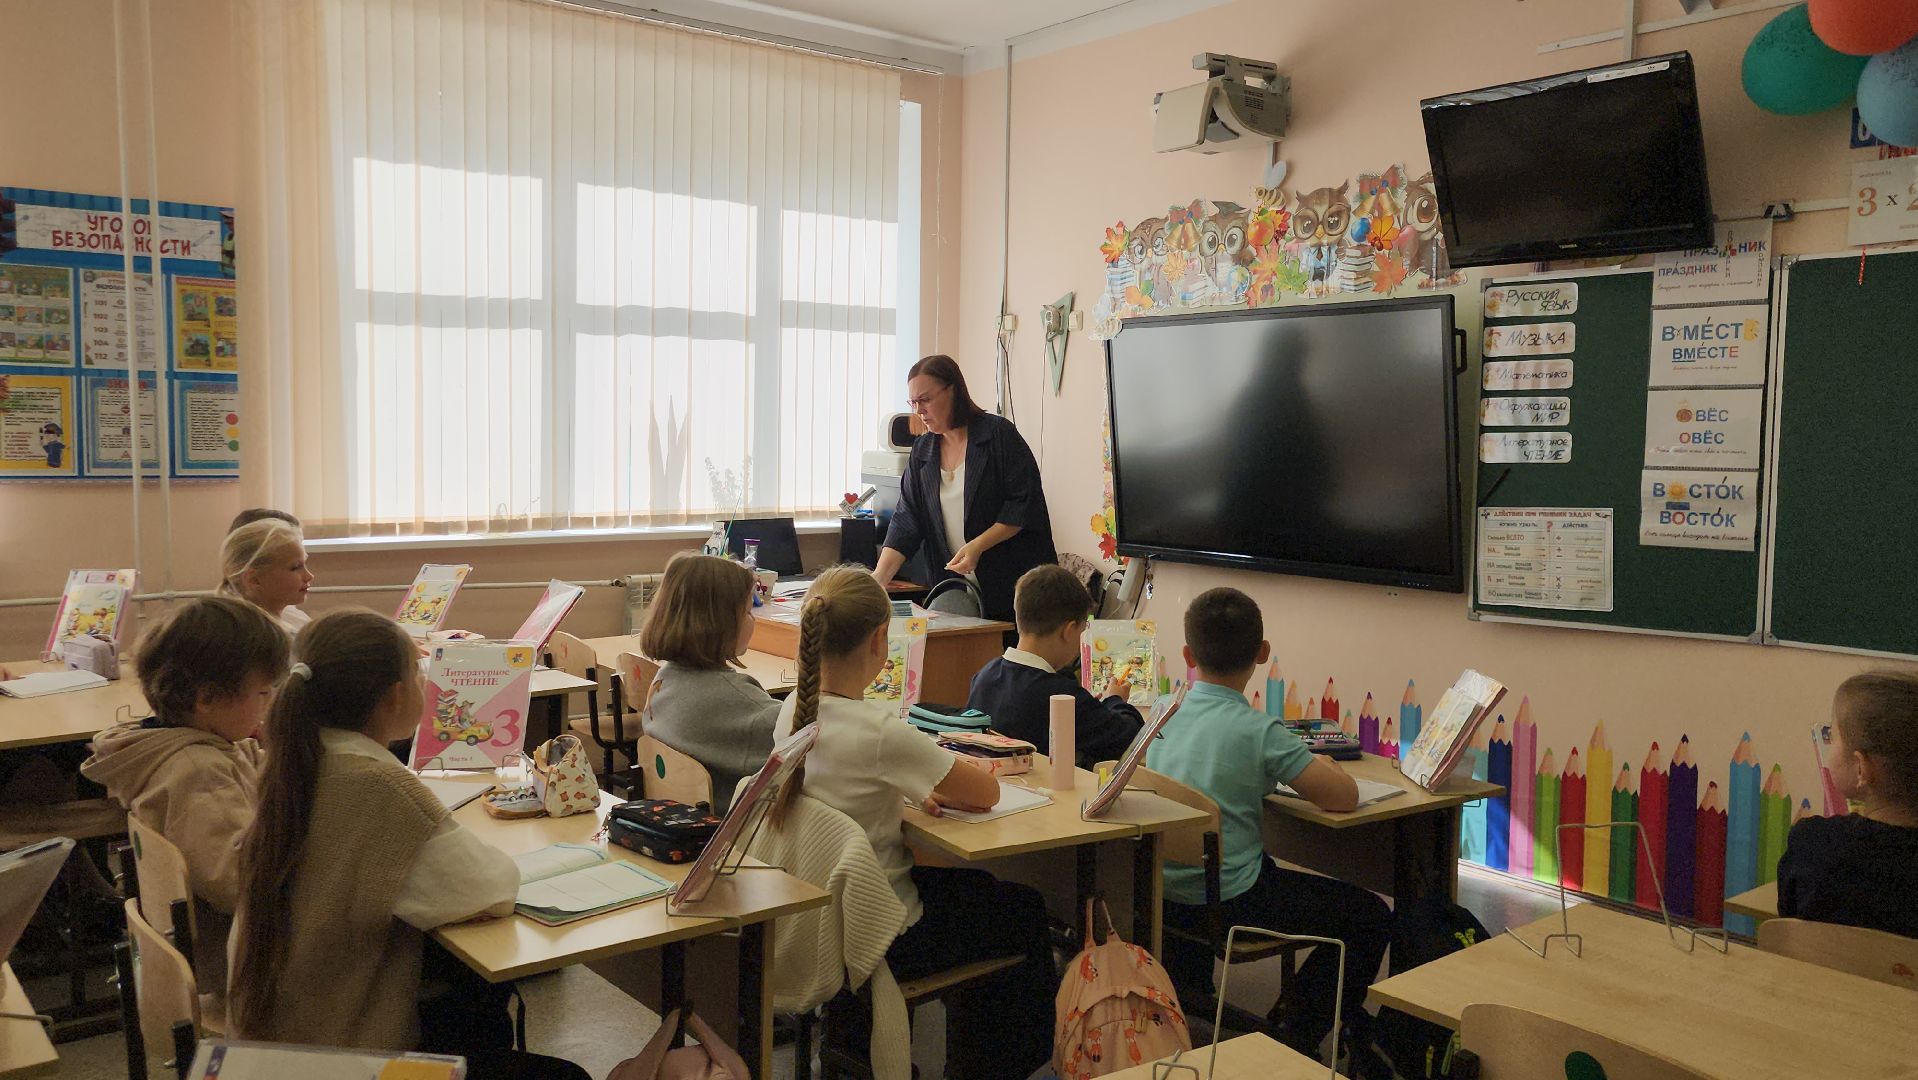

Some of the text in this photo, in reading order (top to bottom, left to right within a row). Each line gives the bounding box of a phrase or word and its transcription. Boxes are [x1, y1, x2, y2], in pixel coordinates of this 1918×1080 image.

[87, 212, 152, 235] УГОО
[53, 230, 191, 257] БЕЗОПАНОСТИ
[1679, 430, 1725, 444] ОВЁС
[441, 667, 510, 678] Литературное
[450, 678, 499, 687] ЧТЕНИЕ
[490, 709, 520, 748] 3
